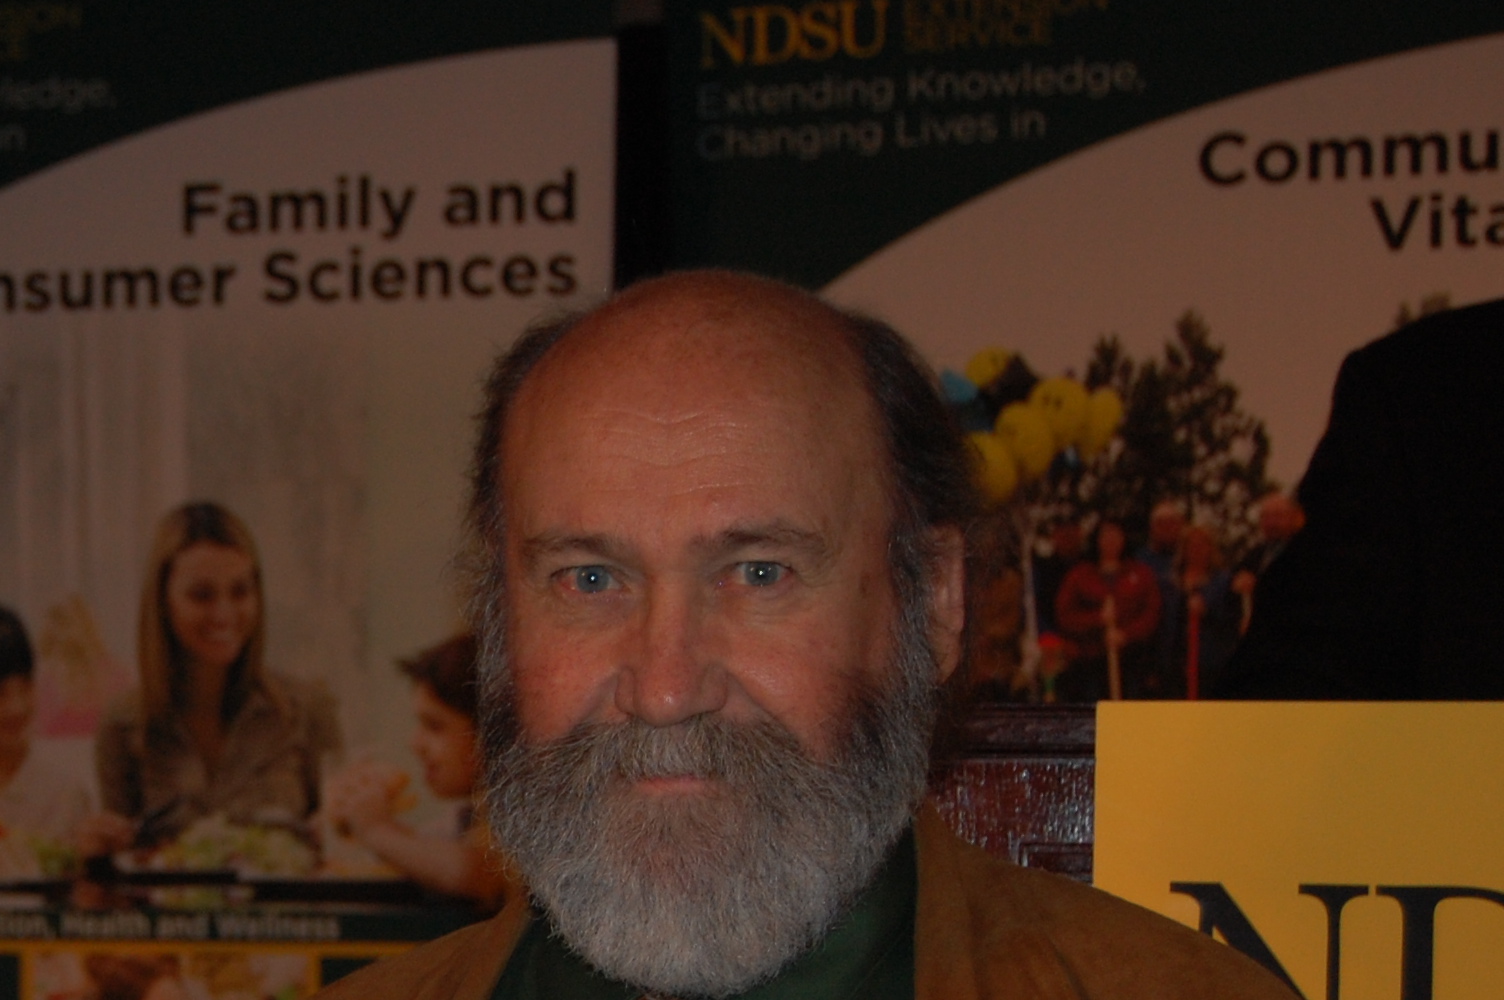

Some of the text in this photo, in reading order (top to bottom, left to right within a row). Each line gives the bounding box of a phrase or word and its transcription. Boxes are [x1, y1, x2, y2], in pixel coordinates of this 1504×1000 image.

[697, 0, 890, 69] NDSU
[696, 73, 895, 120] Extending
[697, 106, 1047, 161] Changing Lives in
[1198, 129, 1502, 187] Commu
[181, 168, 578, 241] Family and
[262, 246, 579, 304] Sciences
[60, 908, 153, 938] Health
[155, 910, 211, 938] and
[213, 909, 342, 940] Wellness
